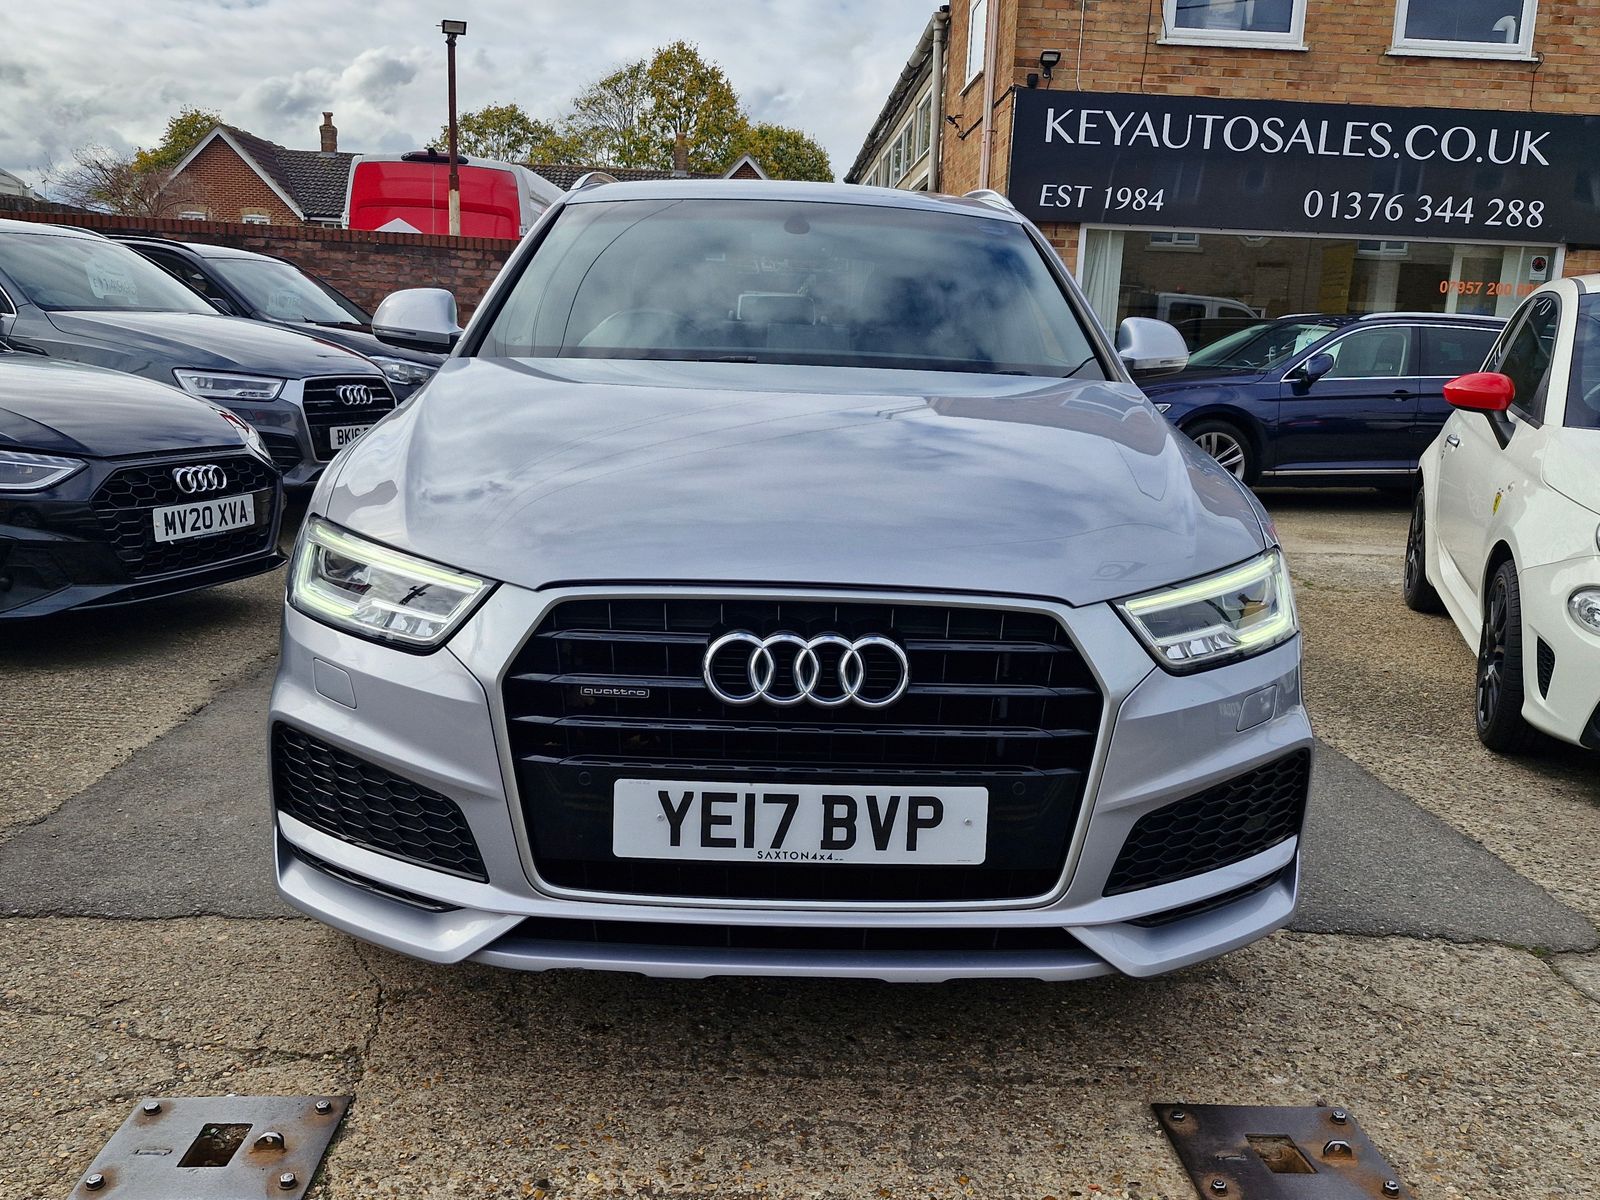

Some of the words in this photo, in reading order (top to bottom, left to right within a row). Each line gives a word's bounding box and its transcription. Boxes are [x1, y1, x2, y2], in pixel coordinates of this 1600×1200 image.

[1045, 108, 1550, 166] KEYAUTOSALES.CO.UK
[1039, 184, 1093, 208] EST
[1104, 186, 1164, 211] 1984
[1303, 190, 1405, 222] 01376
[1414, 194, 1474, 224] 344
[1484, 198, 1545, 228] 288
[1439, 280, 1483, 295] 07957
[163, 506, 214, 537] MV20
[217, 500, 248, 527] XVA
[583, 688, 646, 696] quattro
[658, 790, 800, 849] YE17
[820, 794, 944, 851] BVP
